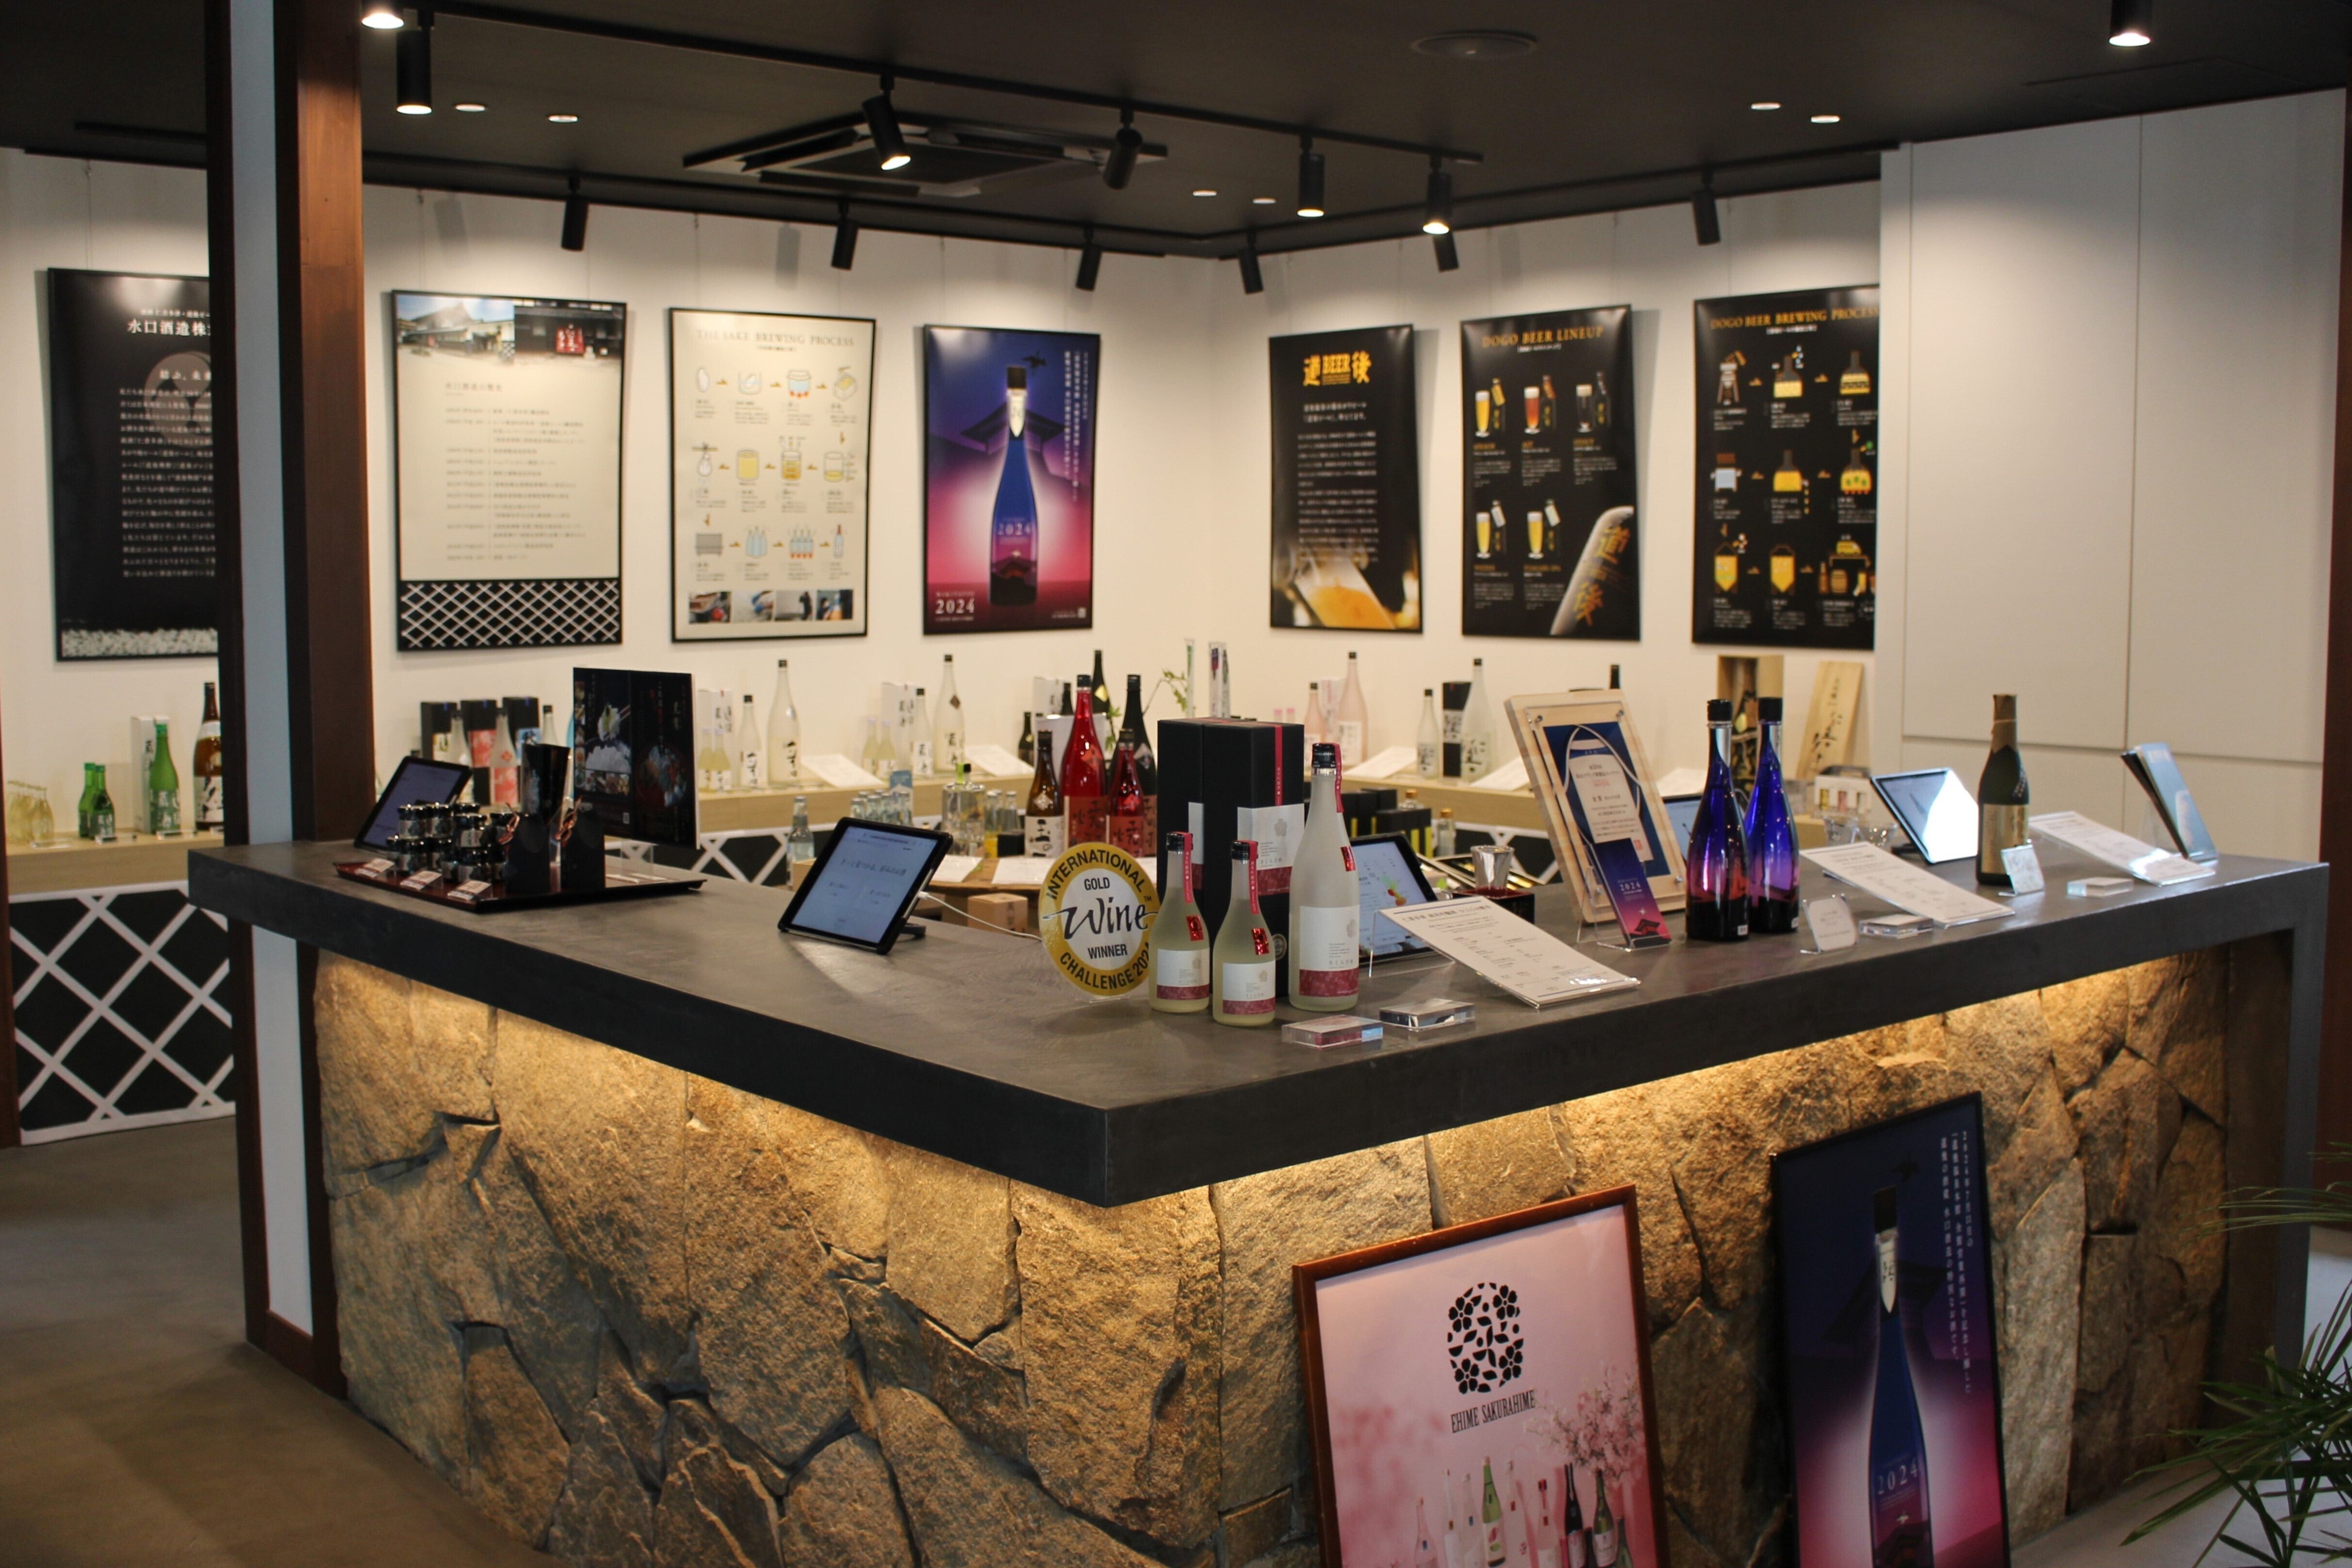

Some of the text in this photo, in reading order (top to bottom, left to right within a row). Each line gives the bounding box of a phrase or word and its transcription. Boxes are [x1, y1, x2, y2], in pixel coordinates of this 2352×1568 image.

[1745, 314, 1771, 327] BEER
[1775, 310, 1827, 325] BREWING
[1522, 329, 1553, 345] BEER
[1556, 325, 1604, 342] LINEUP
[998, 523, 1032, 535] 2024
[935, 597, 975, 609] 2024
[1046, 849, 1144, 900] INTERNATIONAL
[1084, 877, 1110, 890] GOLD
[1043, 897, 1159, 940] Wine
[1088, 944, 1128, 959] WINNER
[1060, 952, 1134, 990] CHALLENGE
[1451, 1389, 1535, 1434] EHIME SAKURAHIME
[1878, 1457, 1917, 1495] 2024
